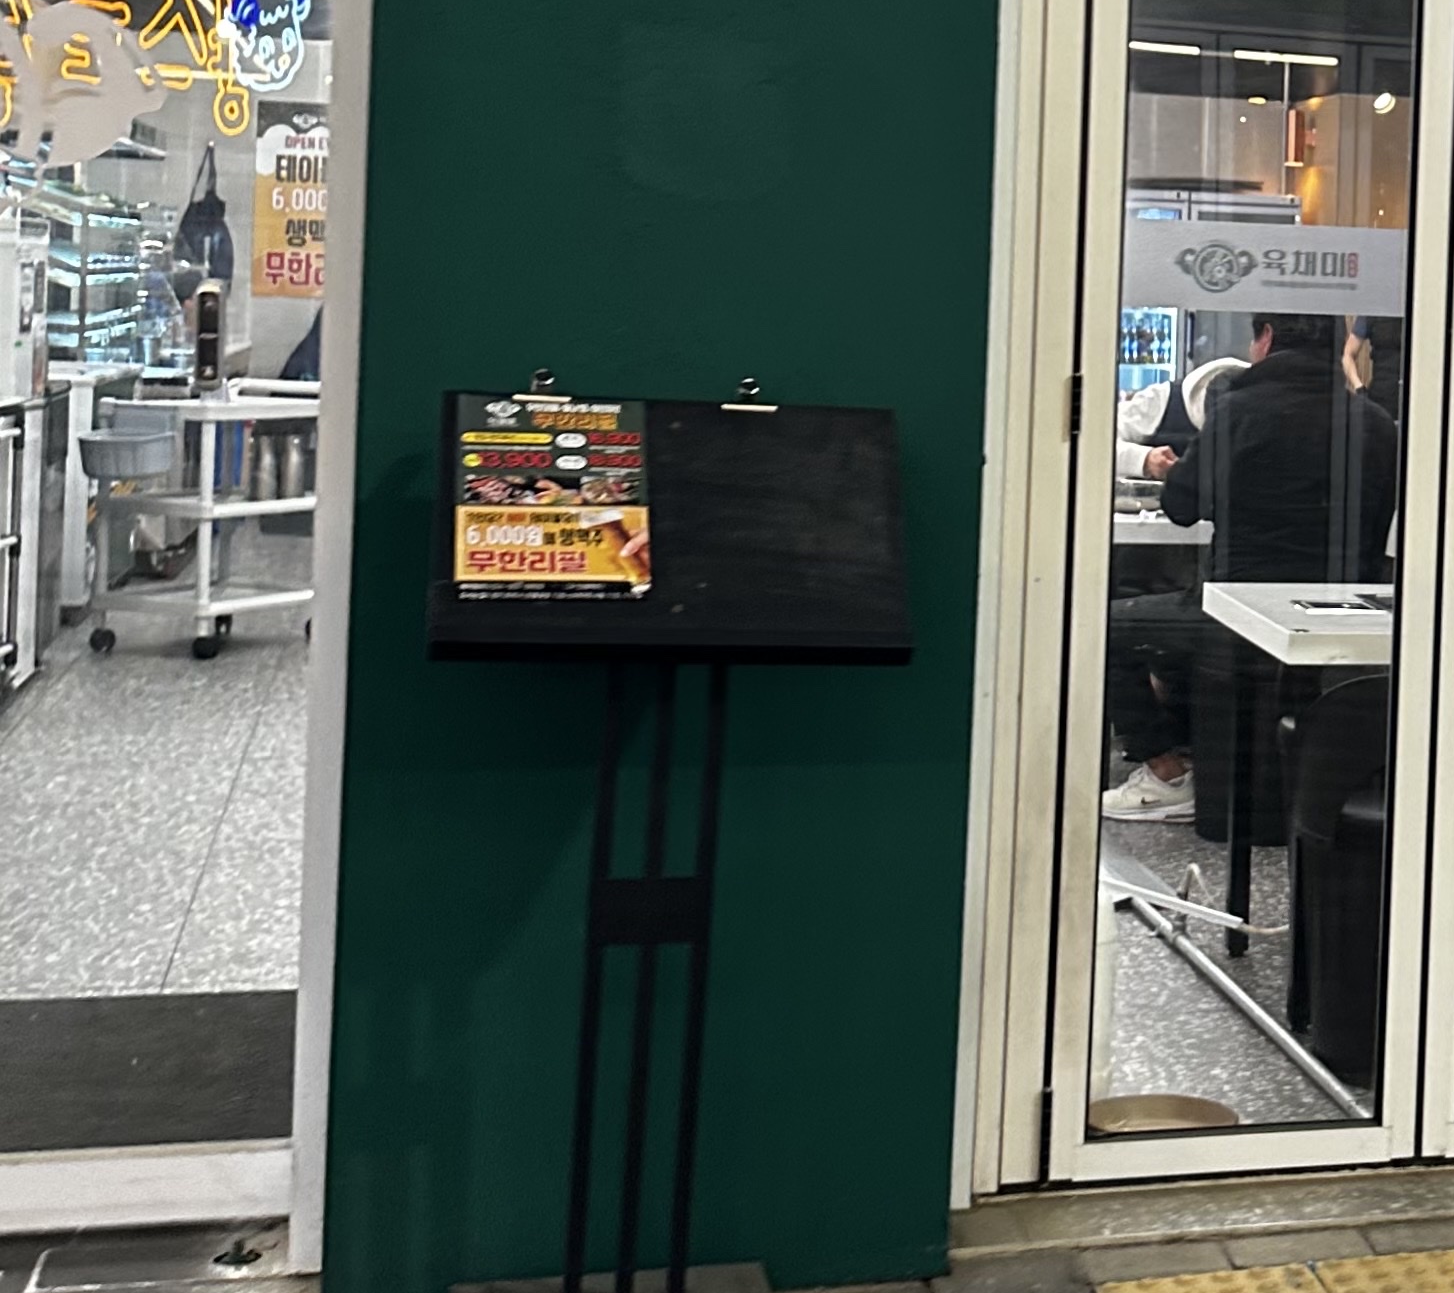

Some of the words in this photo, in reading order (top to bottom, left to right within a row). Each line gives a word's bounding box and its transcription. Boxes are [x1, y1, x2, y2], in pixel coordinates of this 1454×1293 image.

[285, 136, 316, 150] OPEN
[276, 155, 328, 184] 테이
[468, 550, 588, 574] 무한리필
